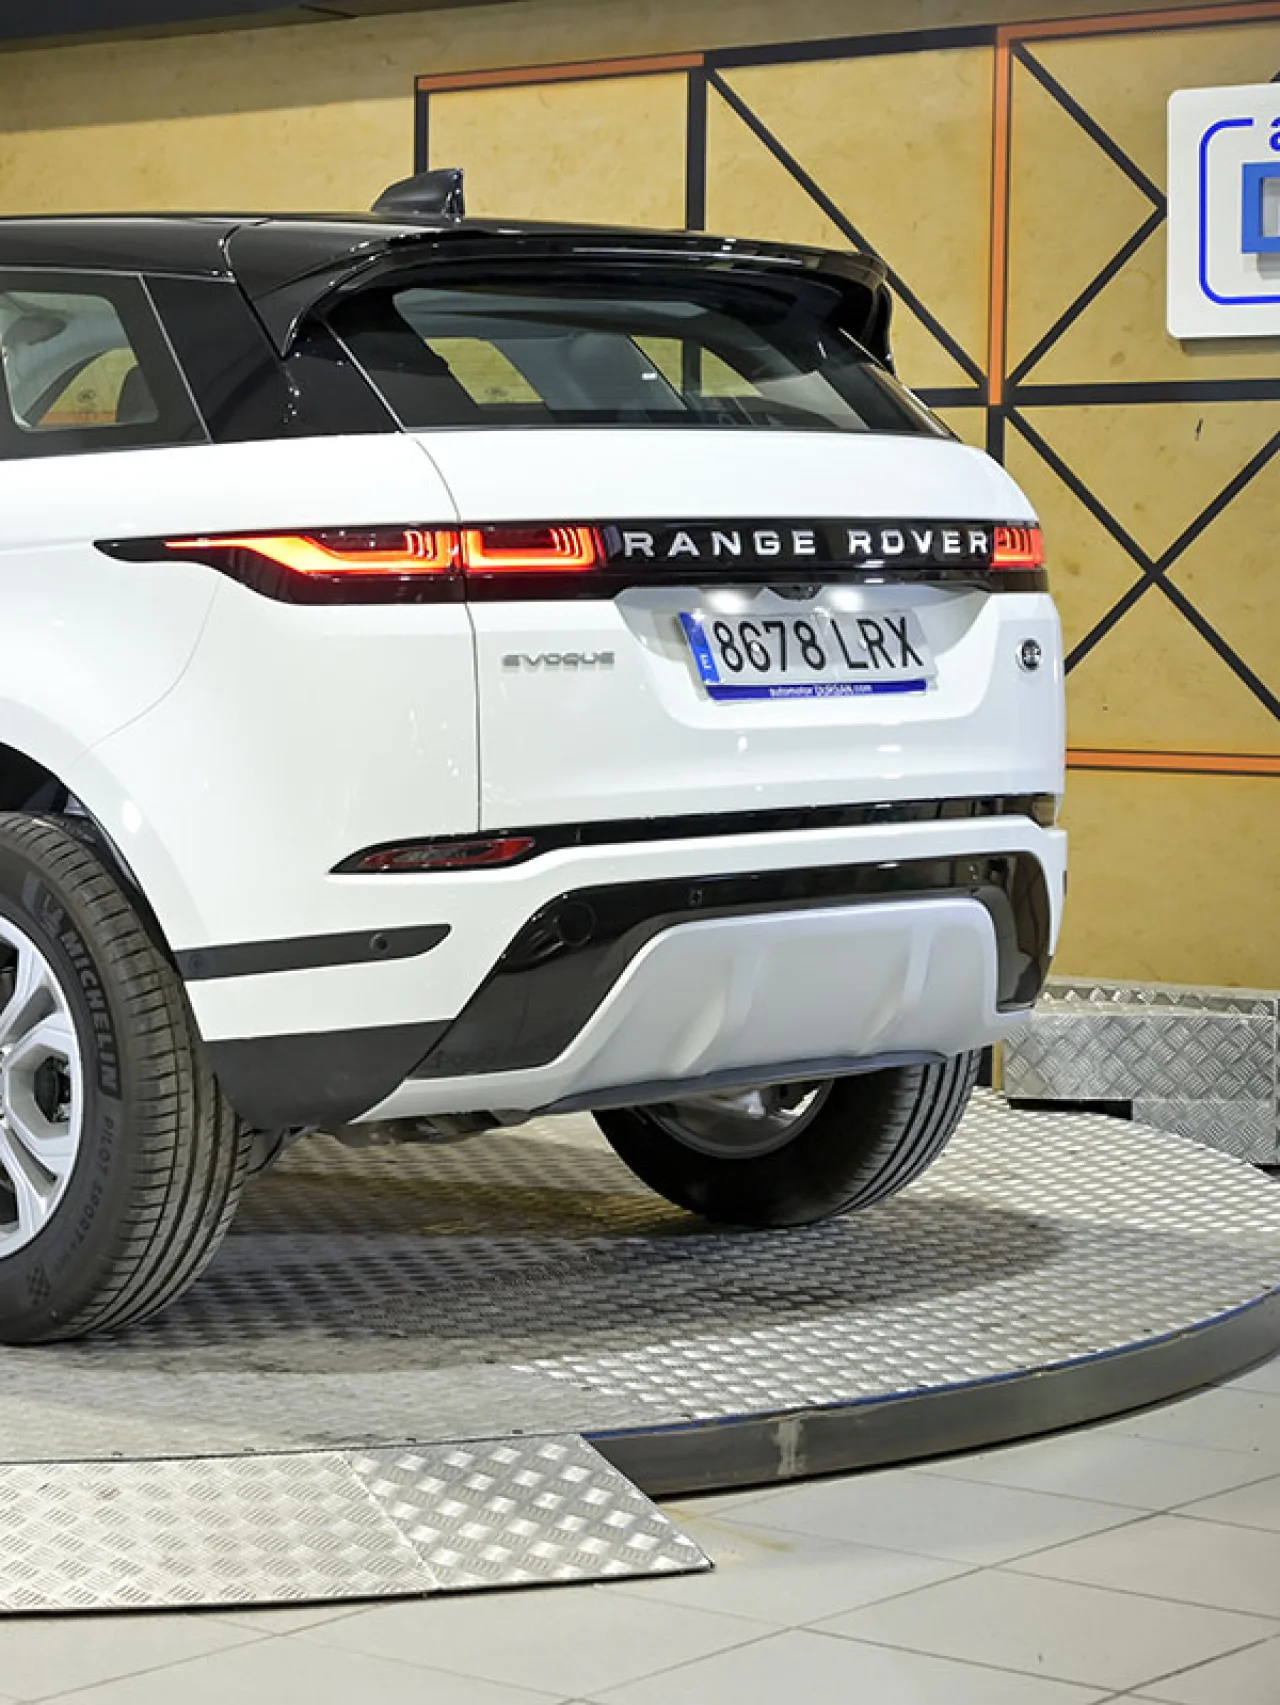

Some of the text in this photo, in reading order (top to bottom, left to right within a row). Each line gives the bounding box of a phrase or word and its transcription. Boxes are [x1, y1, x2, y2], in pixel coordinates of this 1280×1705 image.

[622, 529, 990, 558] RANGE ROVER
[502, 652, 615, 667] EVOQUE
[712, 616, 925, 673] 8678 LRX
[58, 928, 120, 1099] MICHELIN
